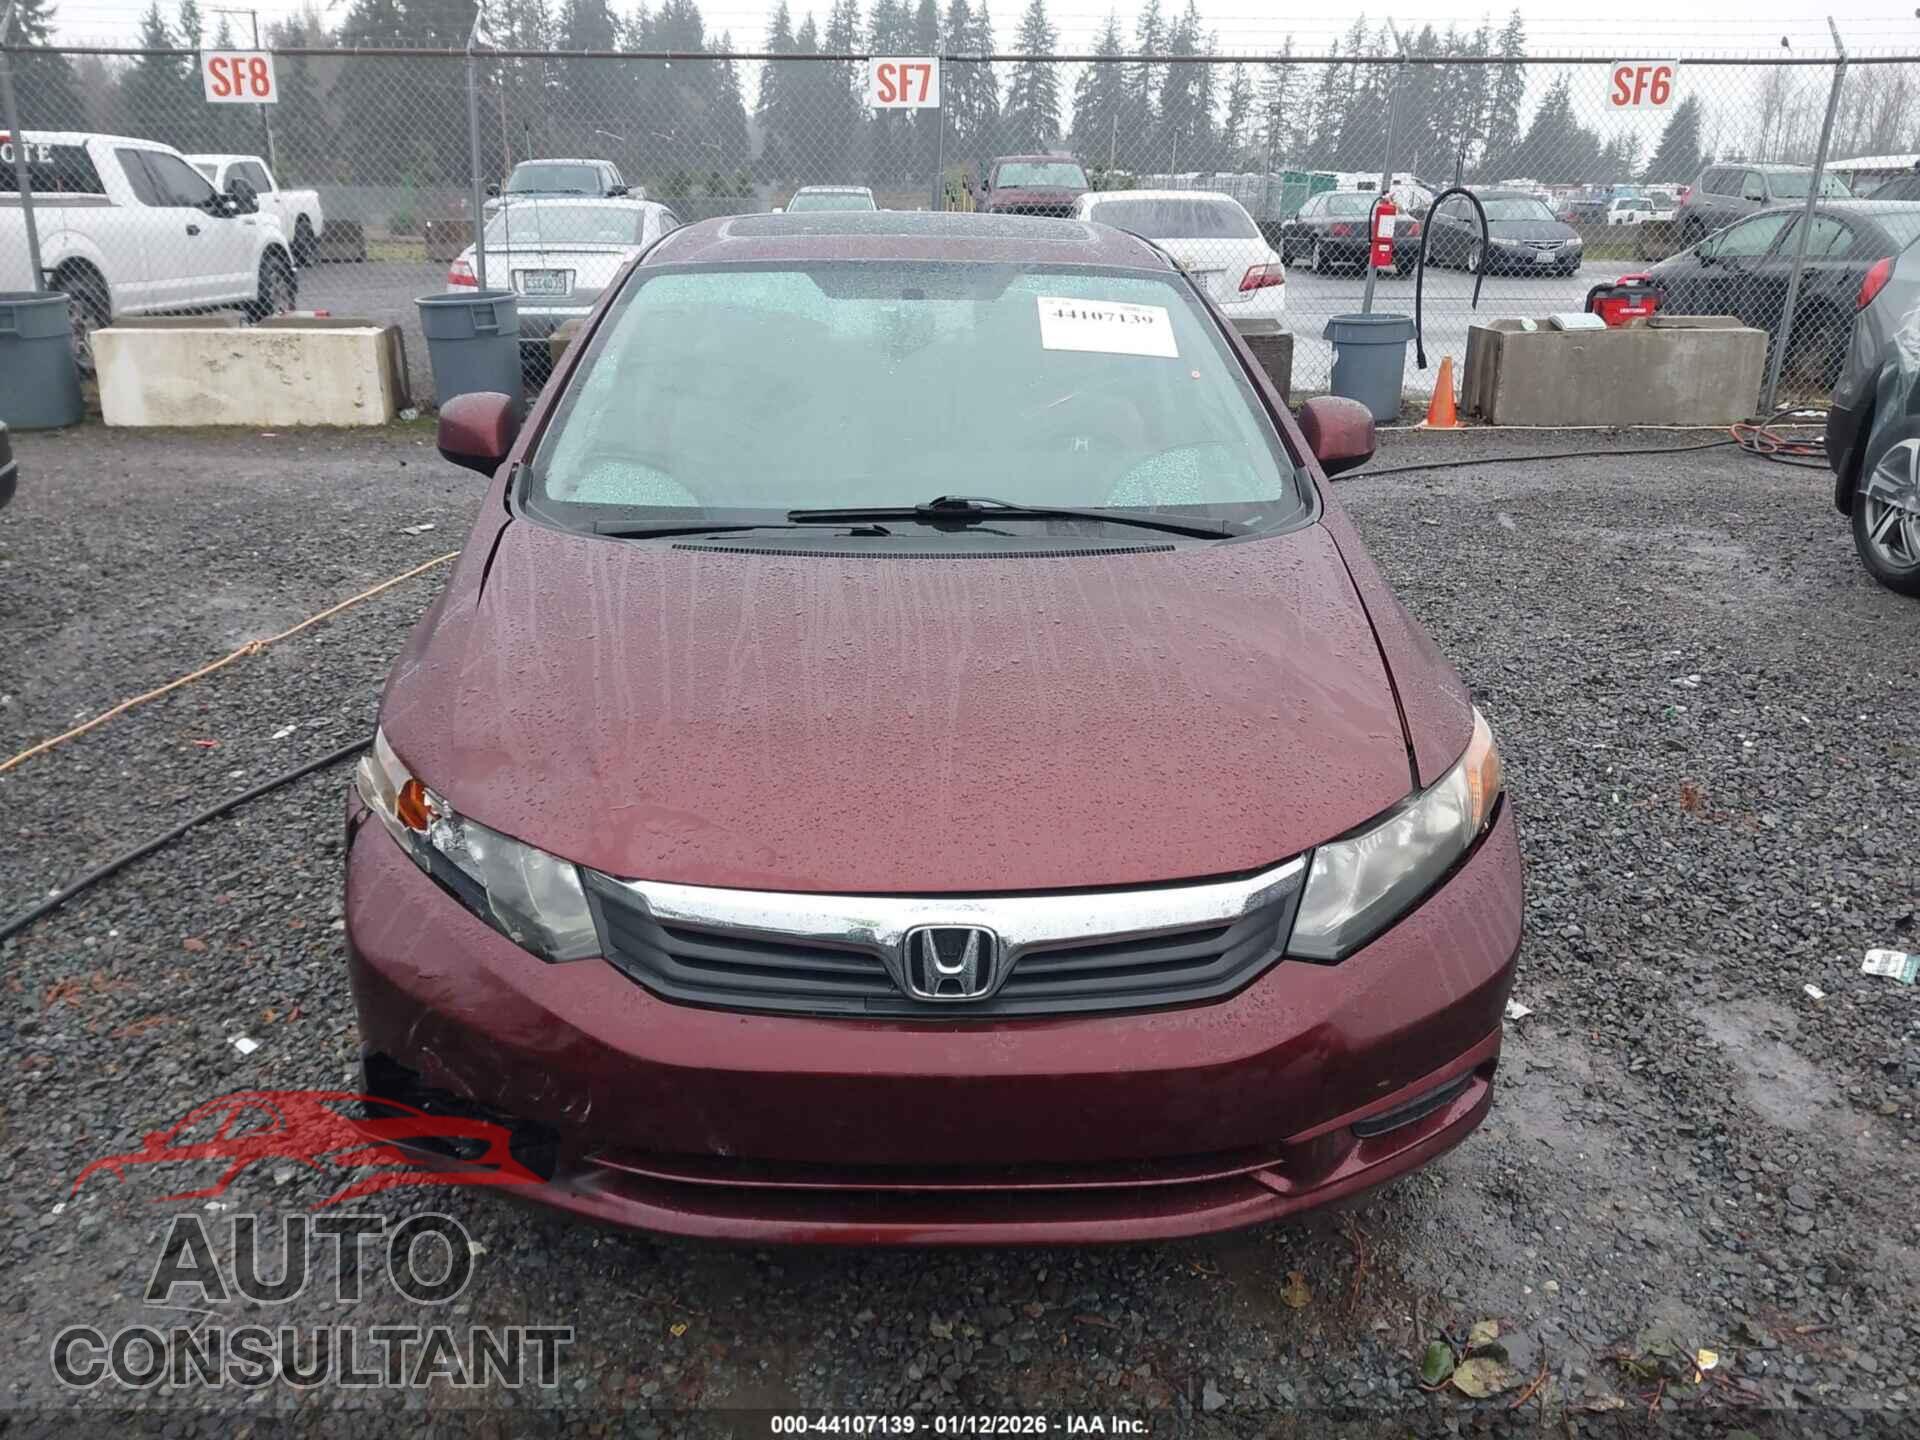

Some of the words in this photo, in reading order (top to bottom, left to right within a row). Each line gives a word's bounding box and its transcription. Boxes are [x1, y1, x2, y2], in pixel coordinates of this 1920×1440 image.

[209, 56, 270, 97] SF8
[877, 63, 931, 102] SF7
[1612, 66, 1672, 106] SF6
[1052, 308, 1154, 325] 44107139
